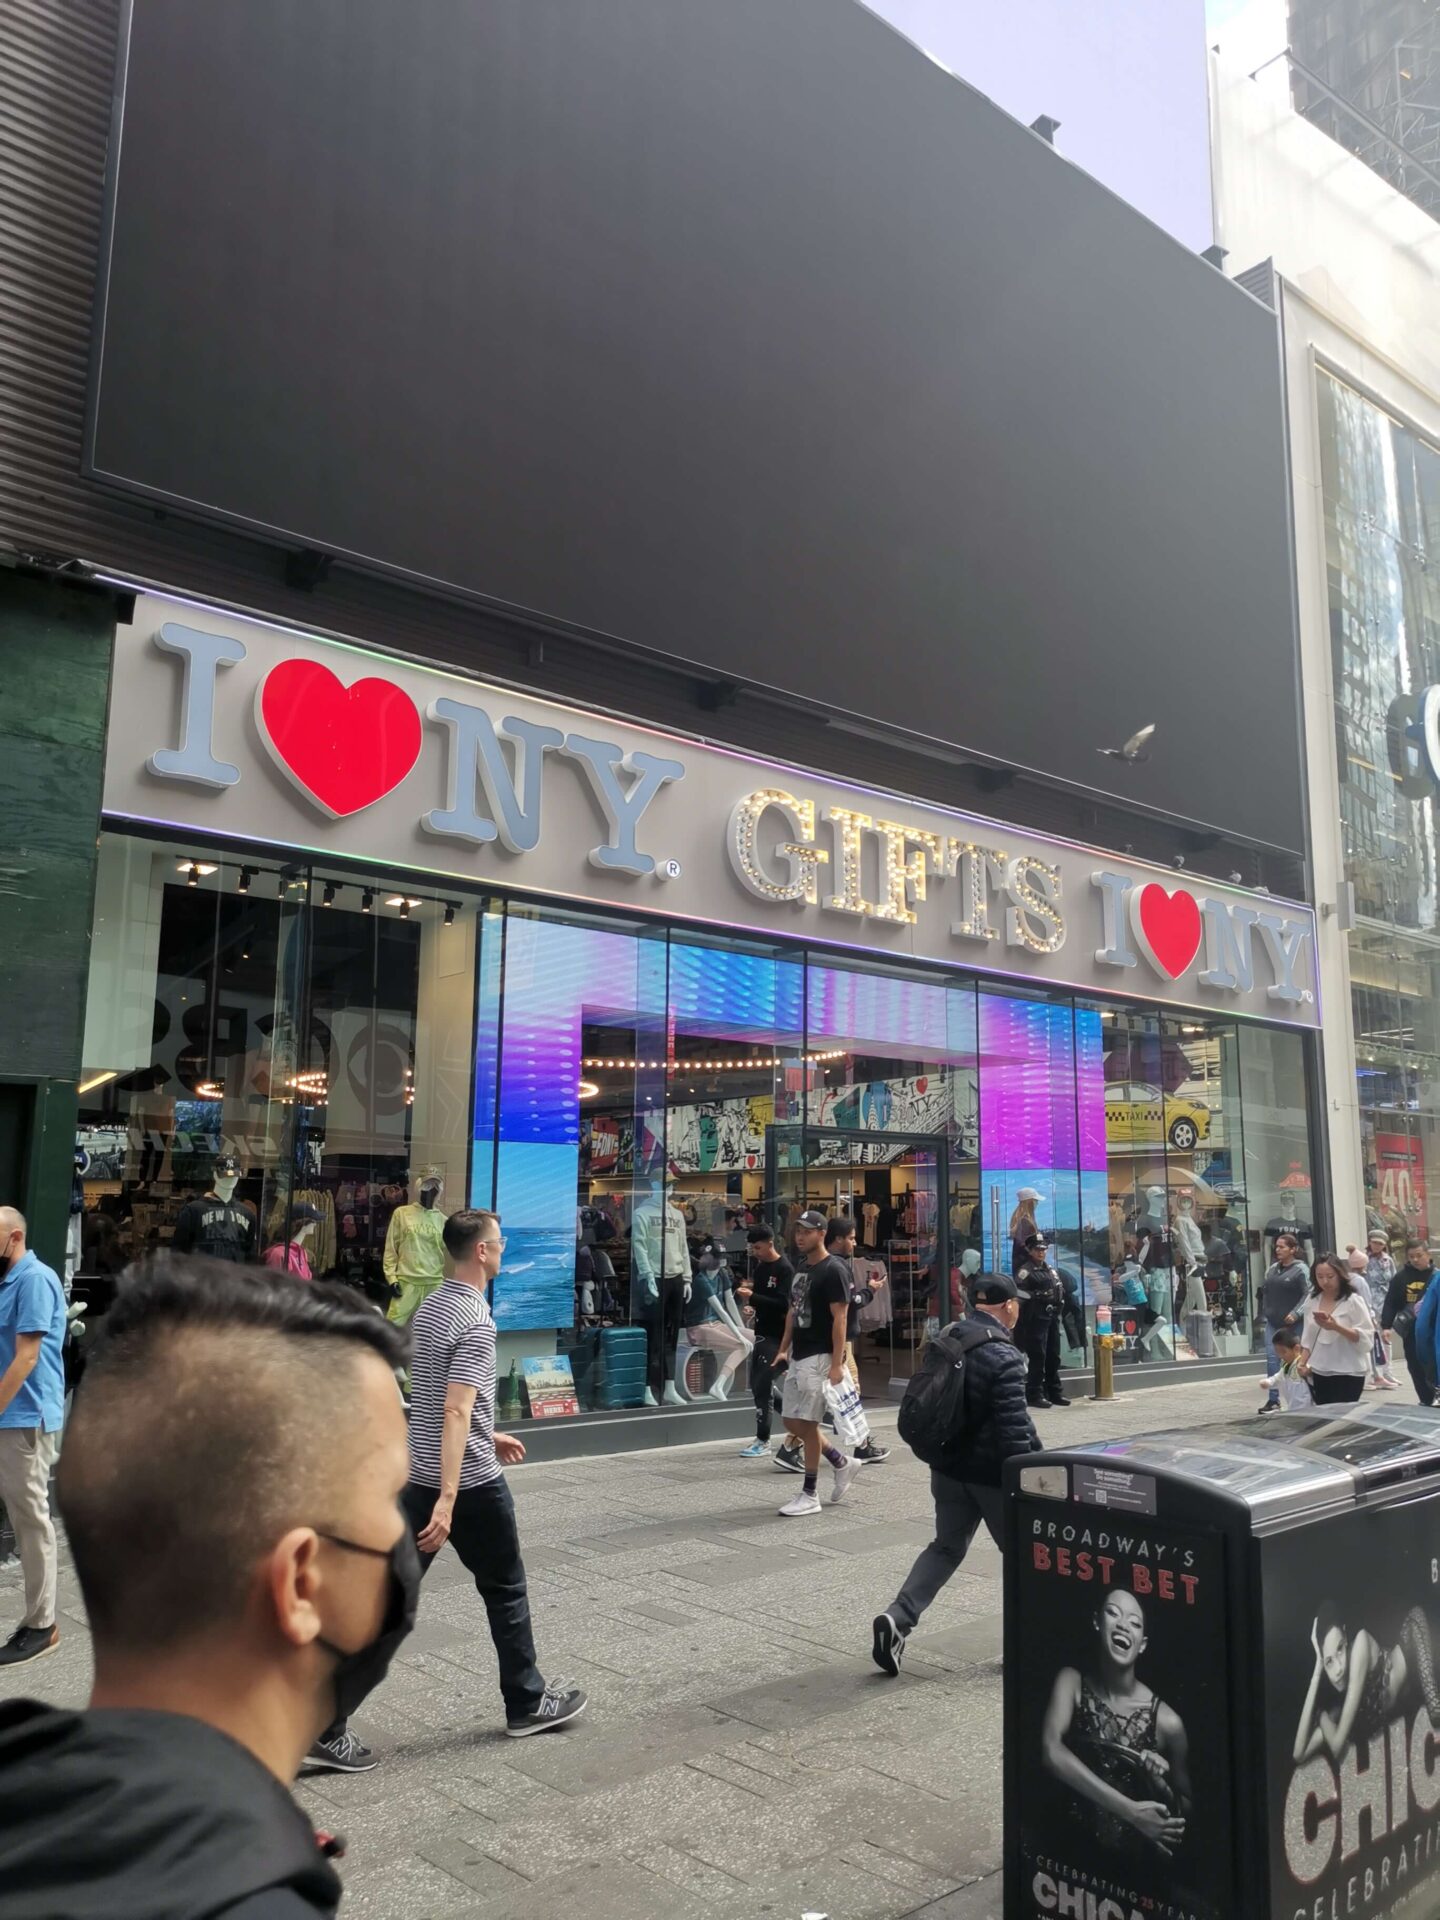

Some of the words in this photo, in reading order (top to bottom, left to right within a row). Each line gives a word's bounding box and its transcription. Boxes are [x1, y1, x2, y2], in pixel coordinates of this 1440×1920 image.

[147, 622, 247, 787] I
[422, 698, 686, 876] NY
[726, 788, 1067, 954] GIFTS
[1091, 871, 1137, 967] I
[1197, 898, 1311, 1002] NY
[1125, 1112, 1144, 1121] TAXI
[1382, 1168, 1411, 1216] 40
[202, 1210, 225, 1228] NEW
[1033, 1519, 1194, 1567] BROADWAY'S
[1033, 1542, 1115, 1584] BEST
[1132, 1563, 1199, 1604] BET
[541, 1698, 559, 1716] N
[1032, 1871, 1145, 1920] CHIC
[1036, 1855, 1138, 1903] CELEBRATING
